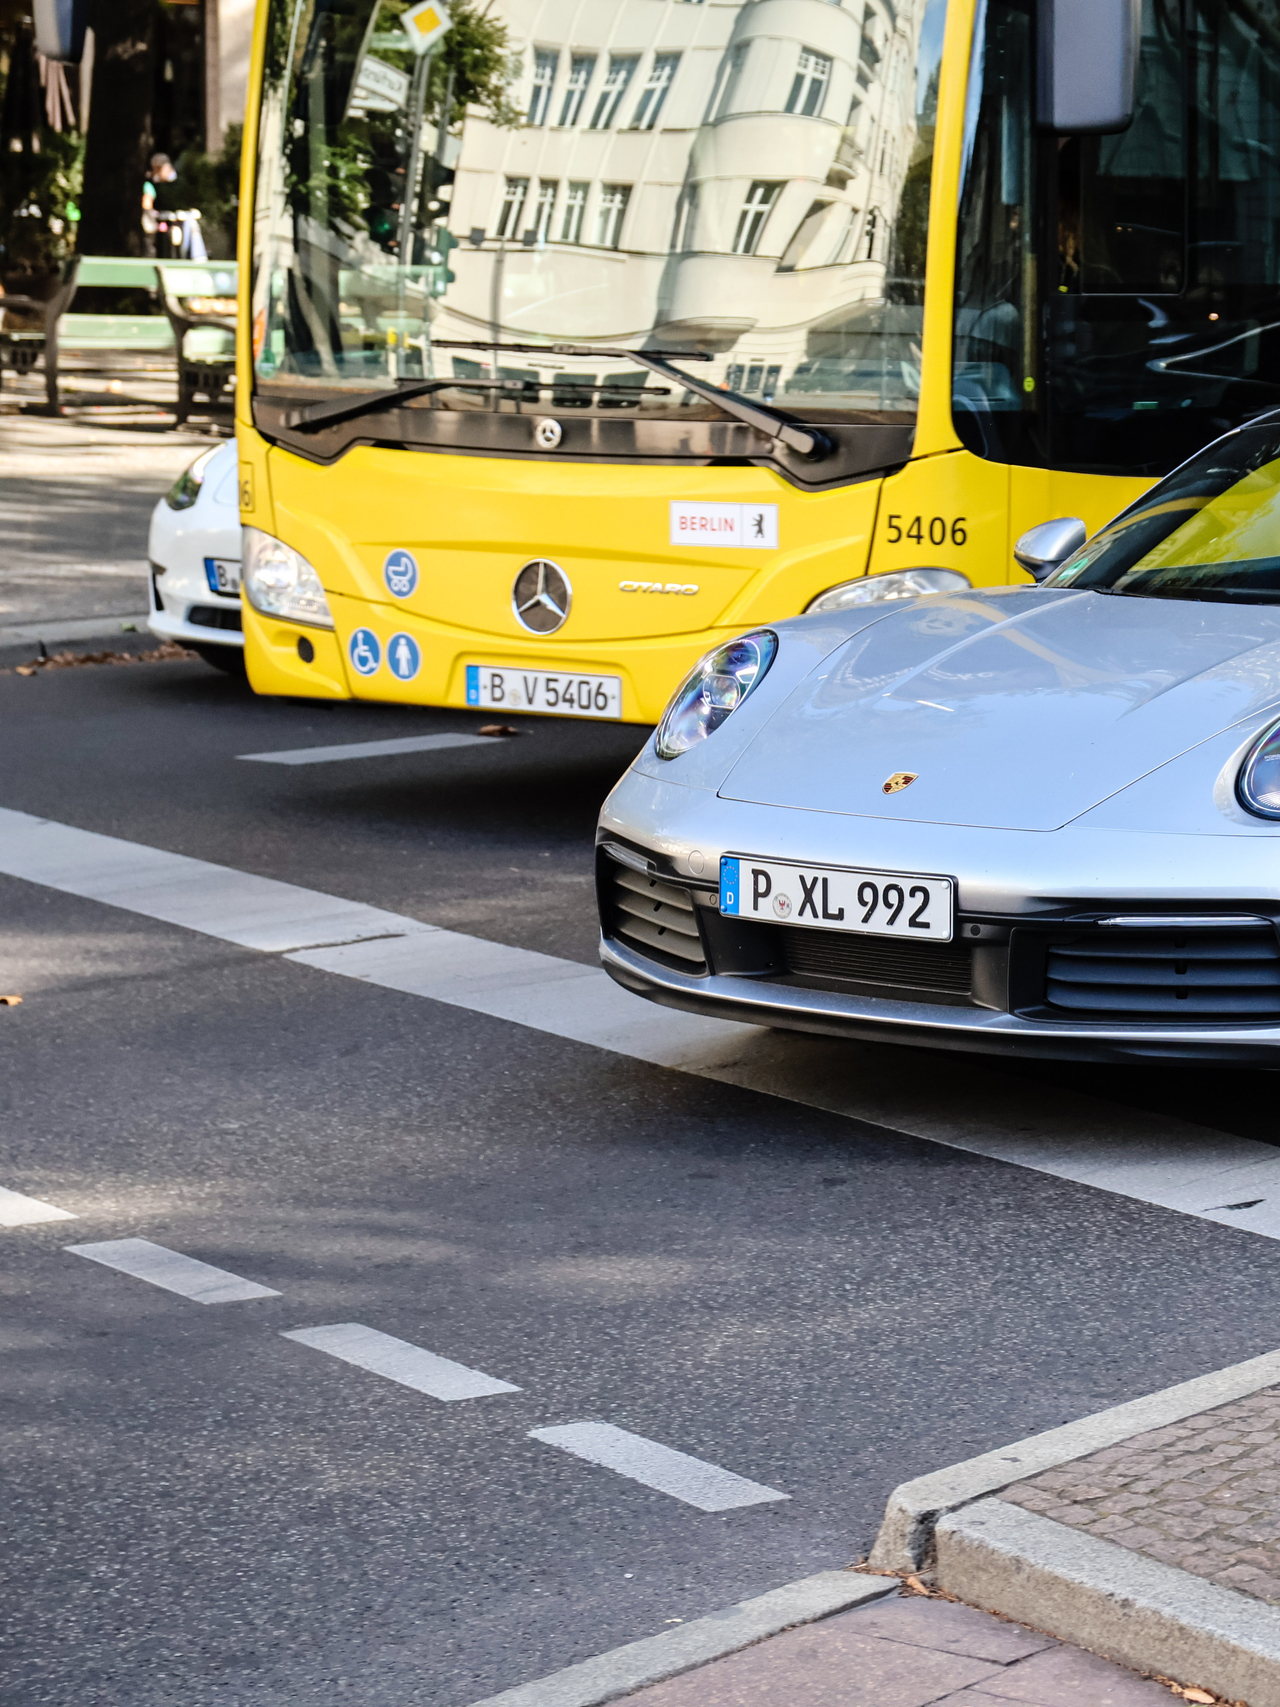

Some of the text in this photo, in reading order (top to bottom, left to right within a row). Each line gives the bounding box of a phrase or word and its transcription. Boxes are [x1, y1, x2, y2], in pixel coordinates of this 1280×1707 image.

[679, 515, 735, 532] BERLIN
[887, 514, 967, 546] 5406
[619, 581, 699, 595] CITARO
[491, 673, 608, 711] B V 5406
[726, 891, 734, 905] D
[751, 868, 930, 929] P XL 992
